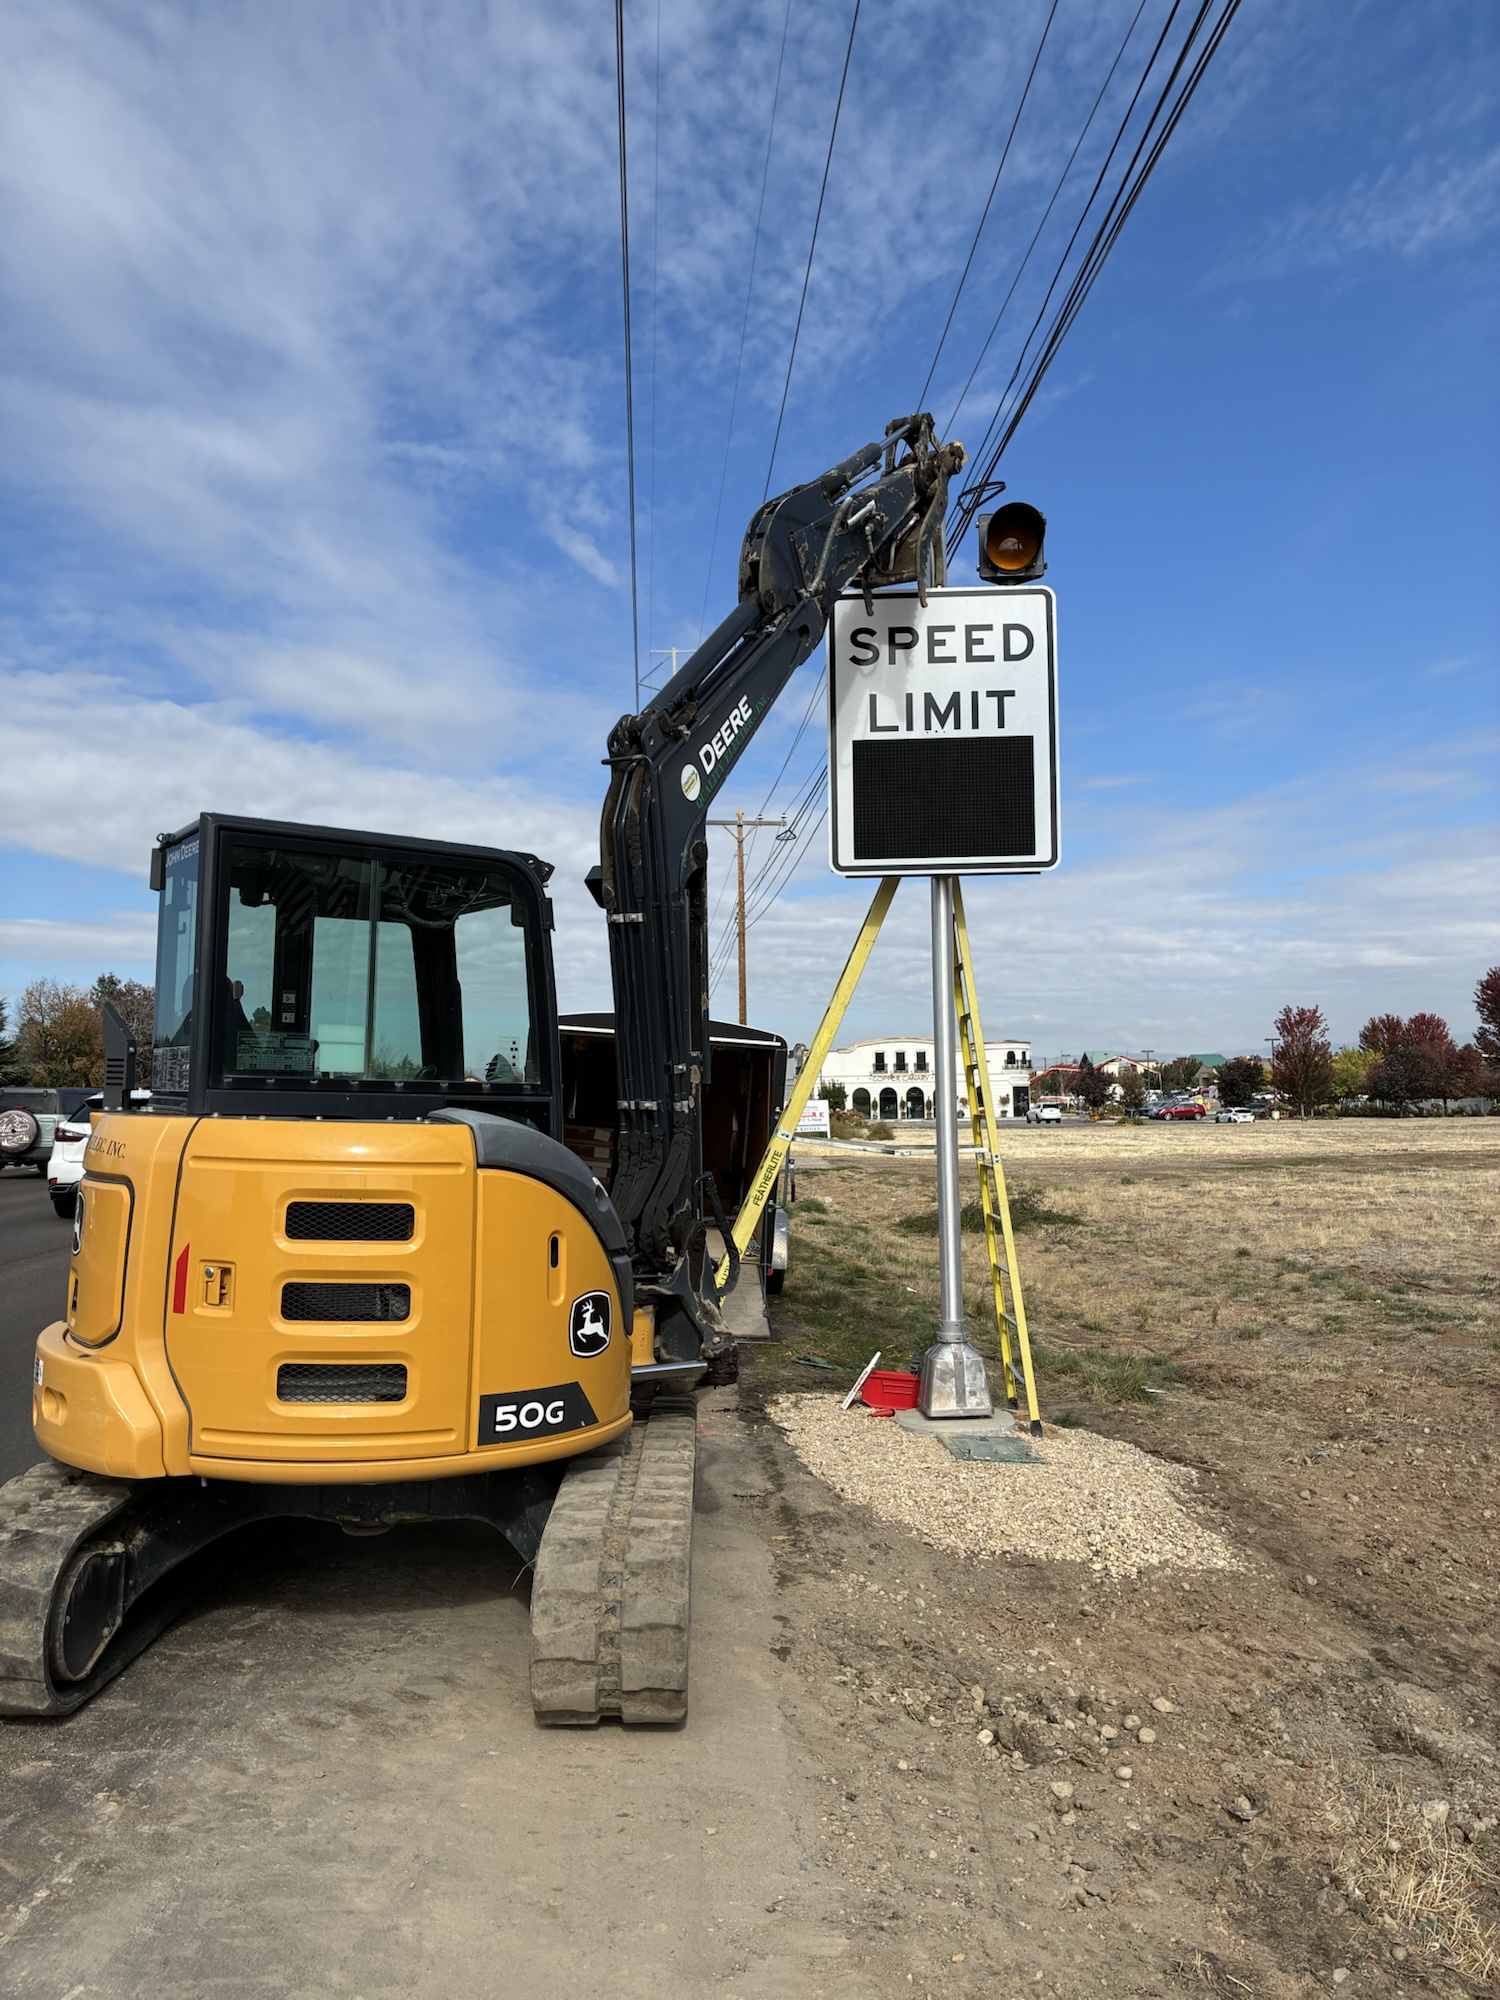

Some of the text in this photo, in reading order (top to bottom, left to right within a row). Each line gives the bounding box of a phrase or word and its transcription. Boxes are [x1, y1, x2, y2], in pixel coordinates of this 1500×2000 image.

[849, 623, 1034, 666] SPEED
[869, 690, 1015, 732] LIMIT
[698, 694, 753, 775] DEERE
[696, 763, 725, 809] QUALITY
[165, 840, 200, 868] JOHN DEERE
[106, 1140, 126, 1159] INC.
[753, 1150, 782, 1207] FEATHERLITE
[495, 1400, 564, 1432] 50G
